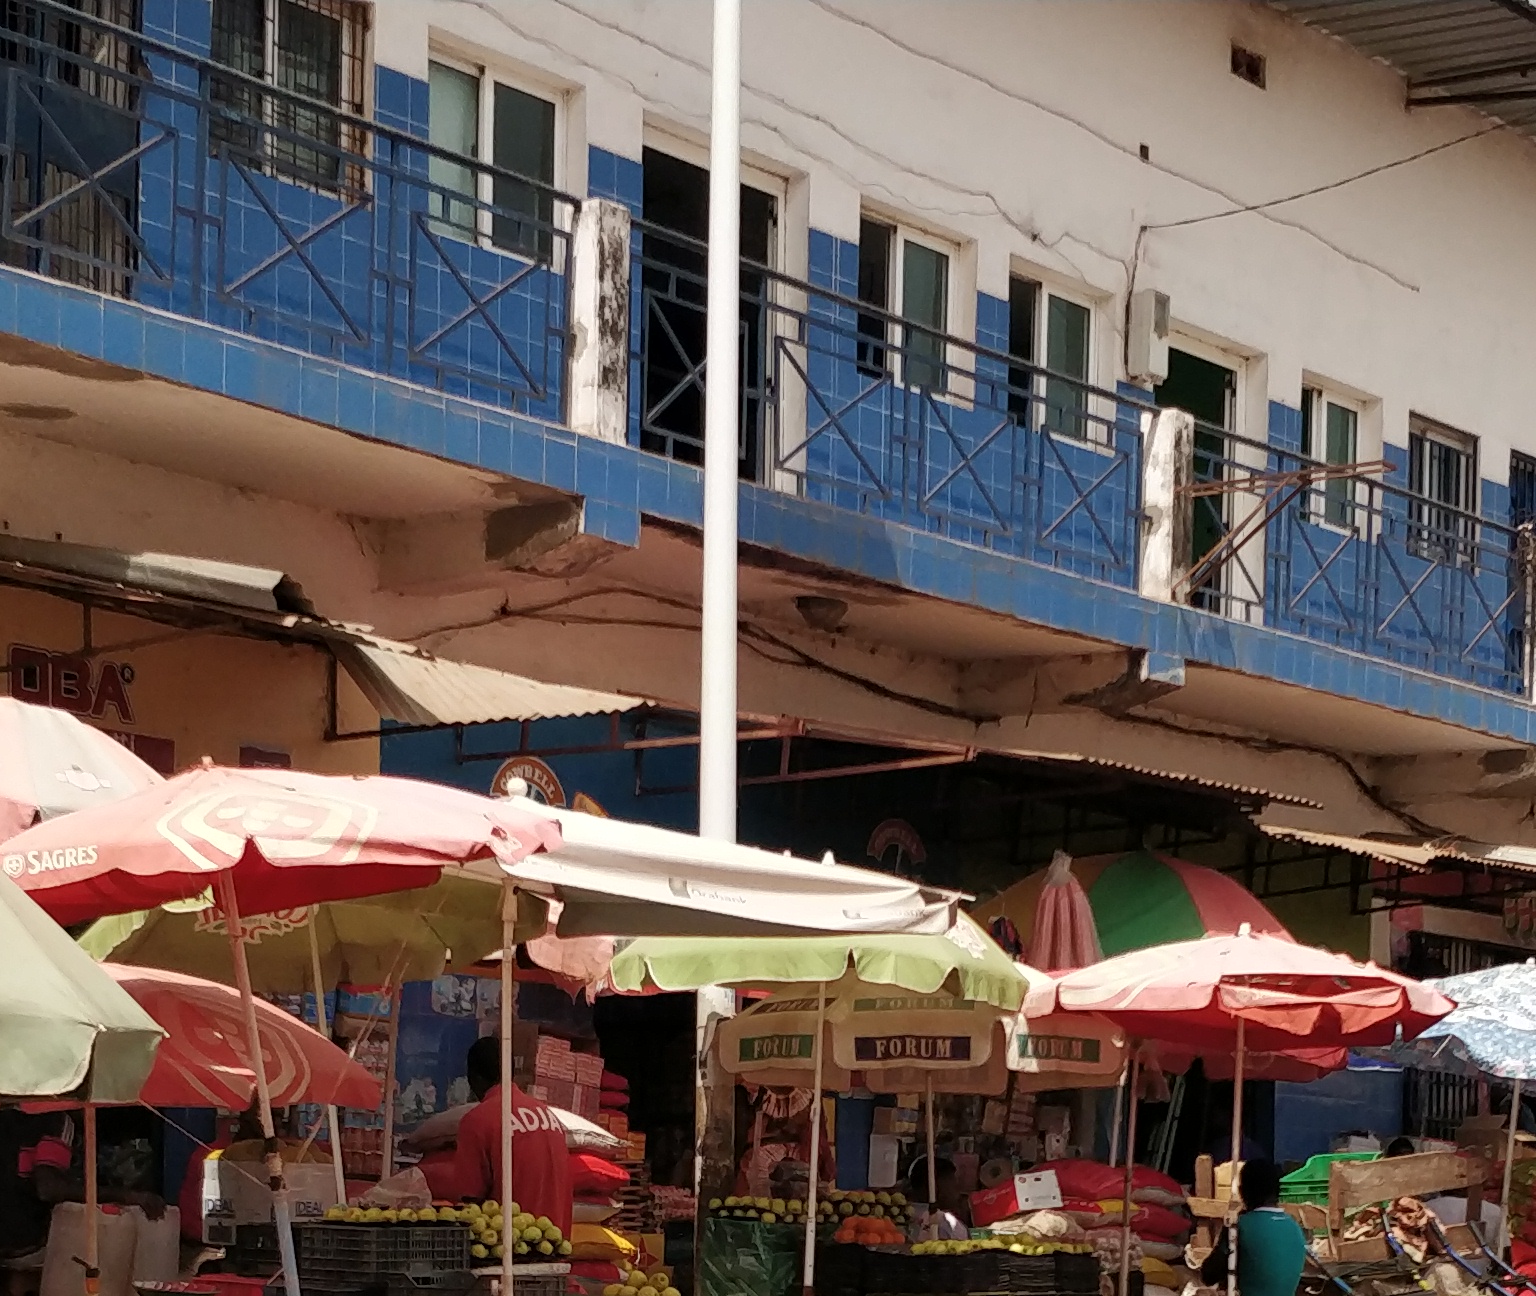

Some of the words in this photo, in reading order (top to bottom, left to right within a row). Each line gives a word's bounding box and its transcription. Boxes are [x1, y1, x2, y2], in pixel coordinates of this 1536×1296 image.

[499, 763, 556, 799] COWBELL
[27, 845, 99, 875] SAGRES
[875, 1037, 952, 1059] FORUM
